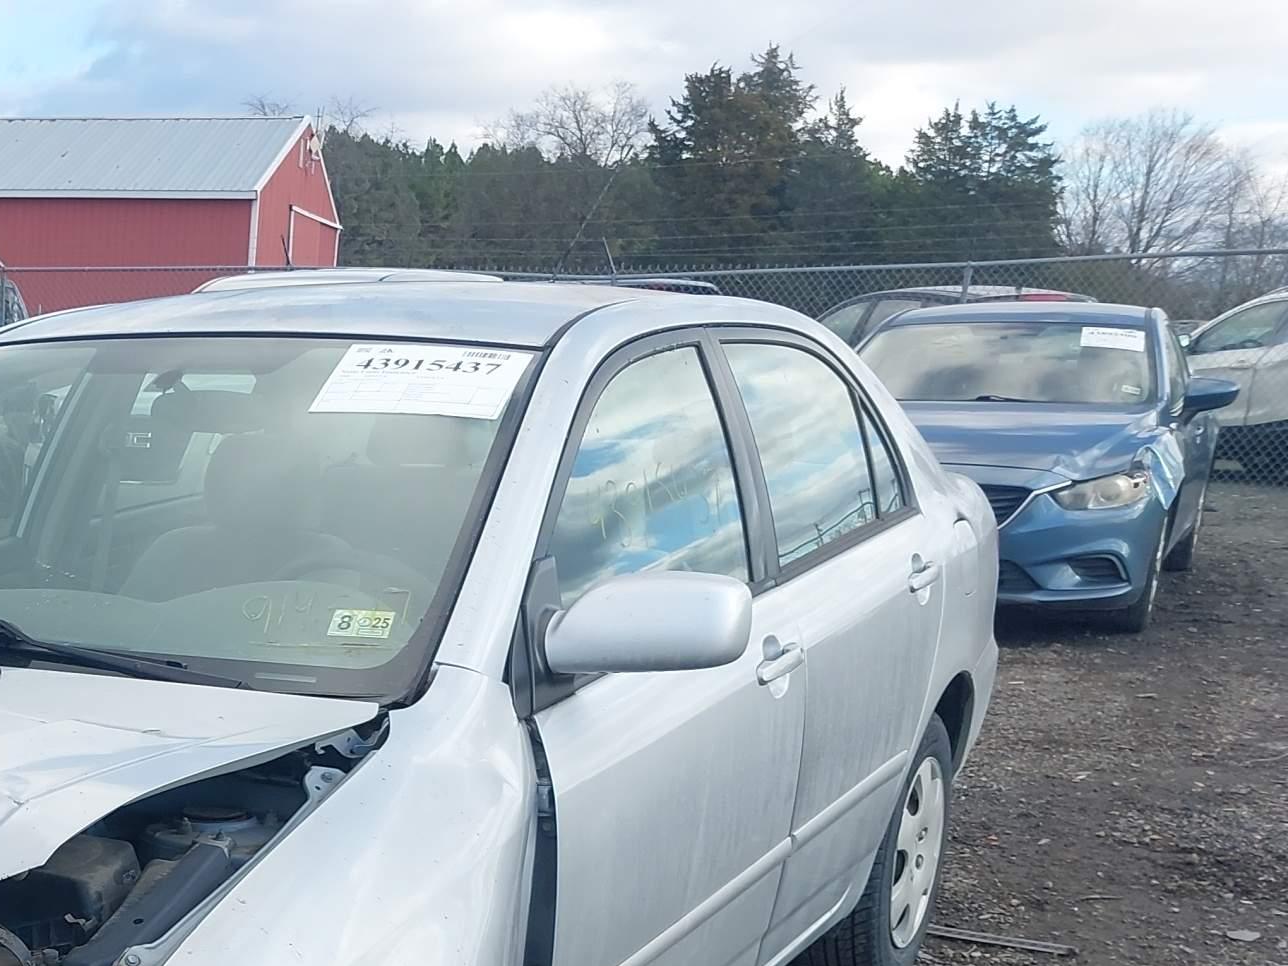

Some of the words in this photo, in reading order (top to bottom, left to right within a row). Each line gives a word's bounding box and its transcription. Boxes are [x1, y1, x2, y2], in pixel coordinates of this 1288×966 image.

[355, 357, 502, 376] 43915437
[337, 614, 353, 631] 8
[371, 616, 391, 630] 25
